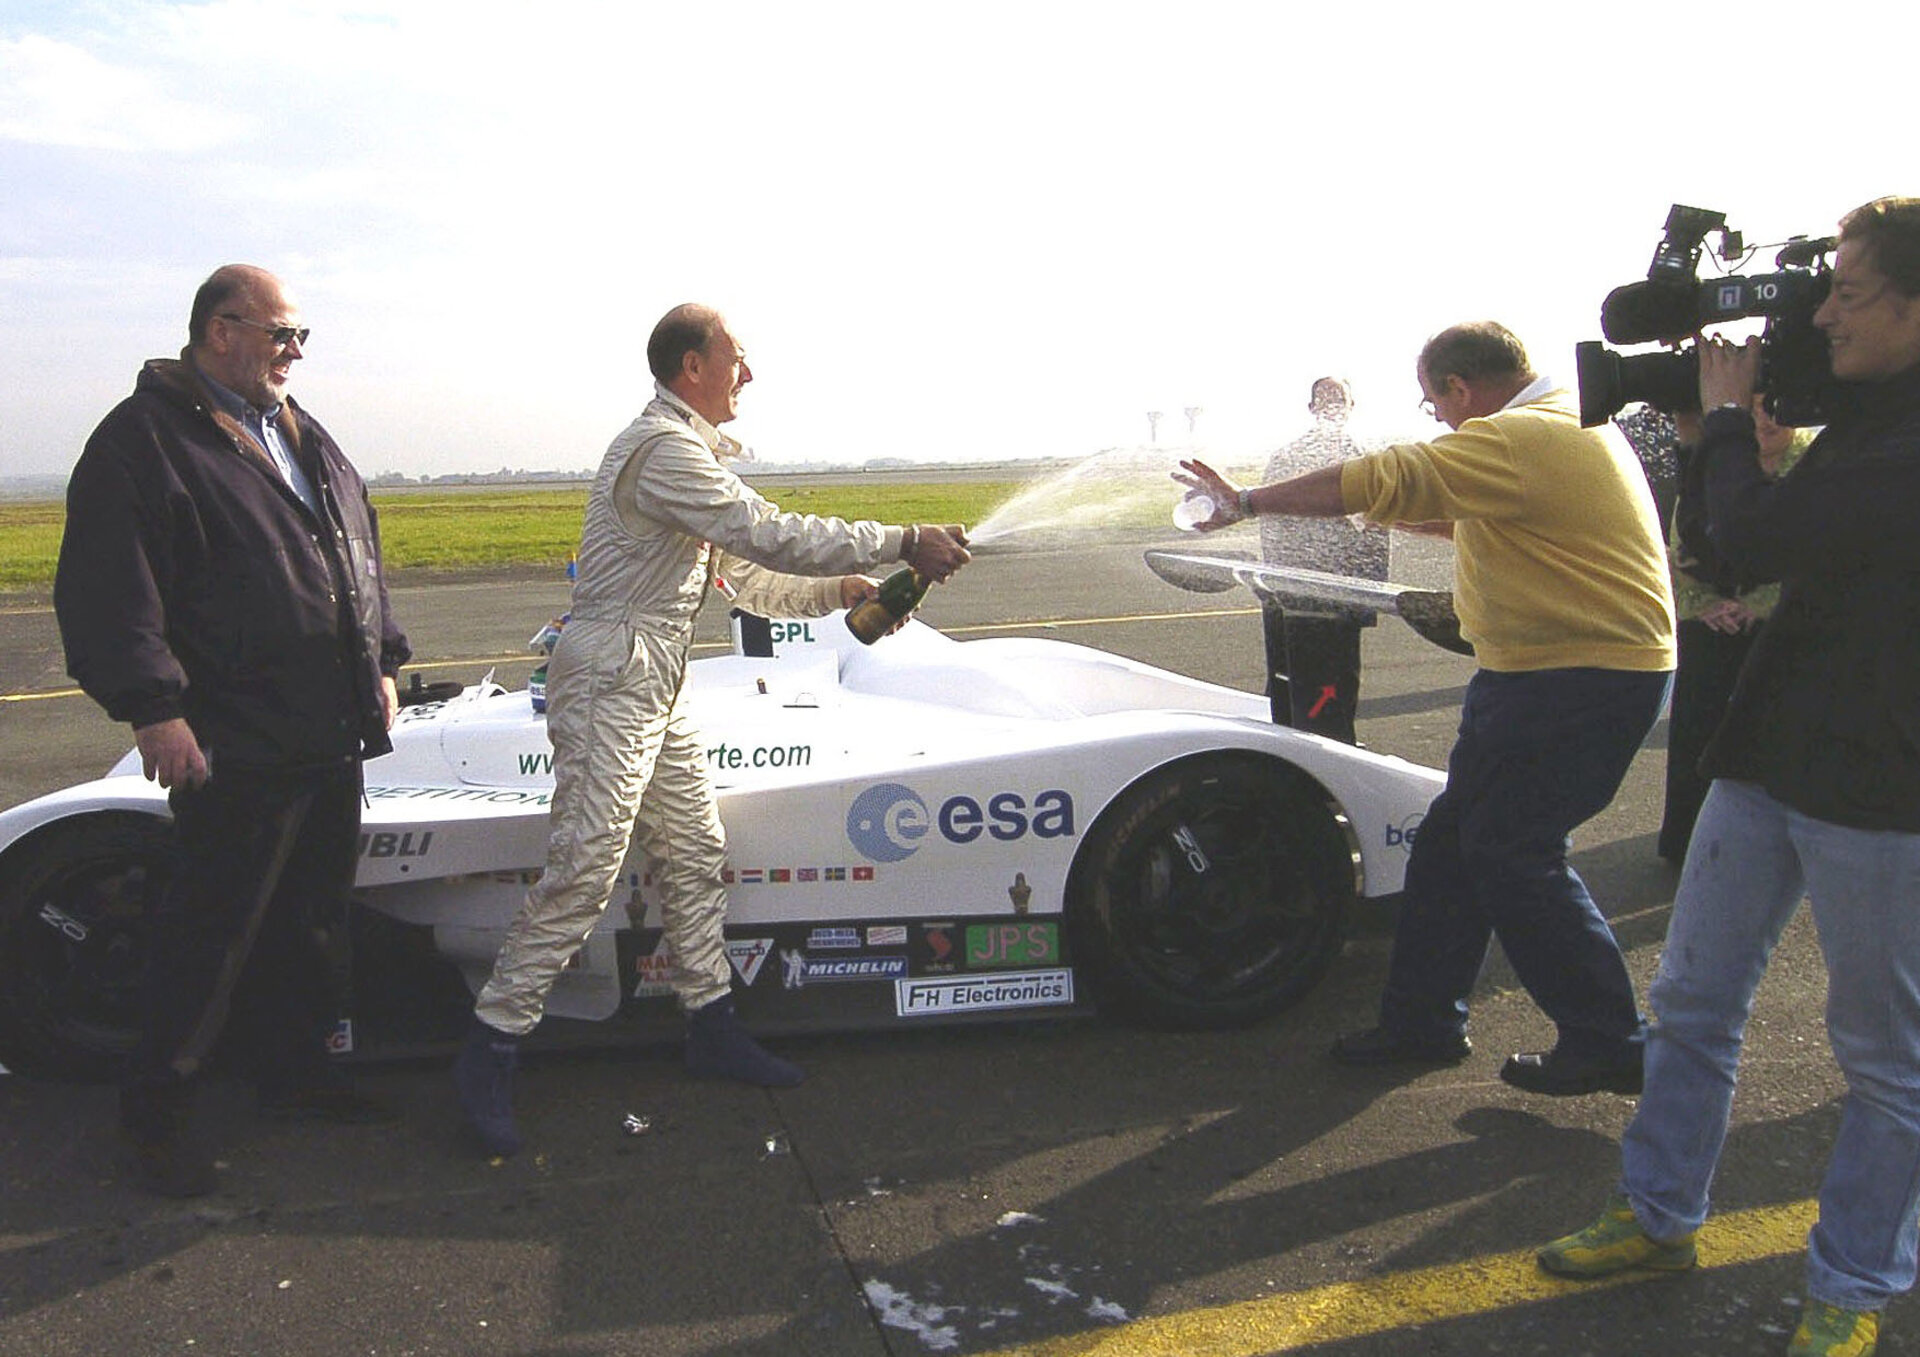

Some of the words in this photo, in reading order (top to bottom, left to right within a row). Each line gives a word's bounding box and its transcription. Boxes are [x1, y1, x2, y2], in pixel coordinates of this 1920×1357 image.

[1754, 284, 1777, 300] 10
[769, 622, 815, 642] GPL
[938, 789, 1075, 844] esa
[974, 924, 1050, 960] JPS
[808, 960, 904, 976] MICHELIN
[908, 985, 941, 1008] FH
[952, 983, 1064, 1005] Electronics
